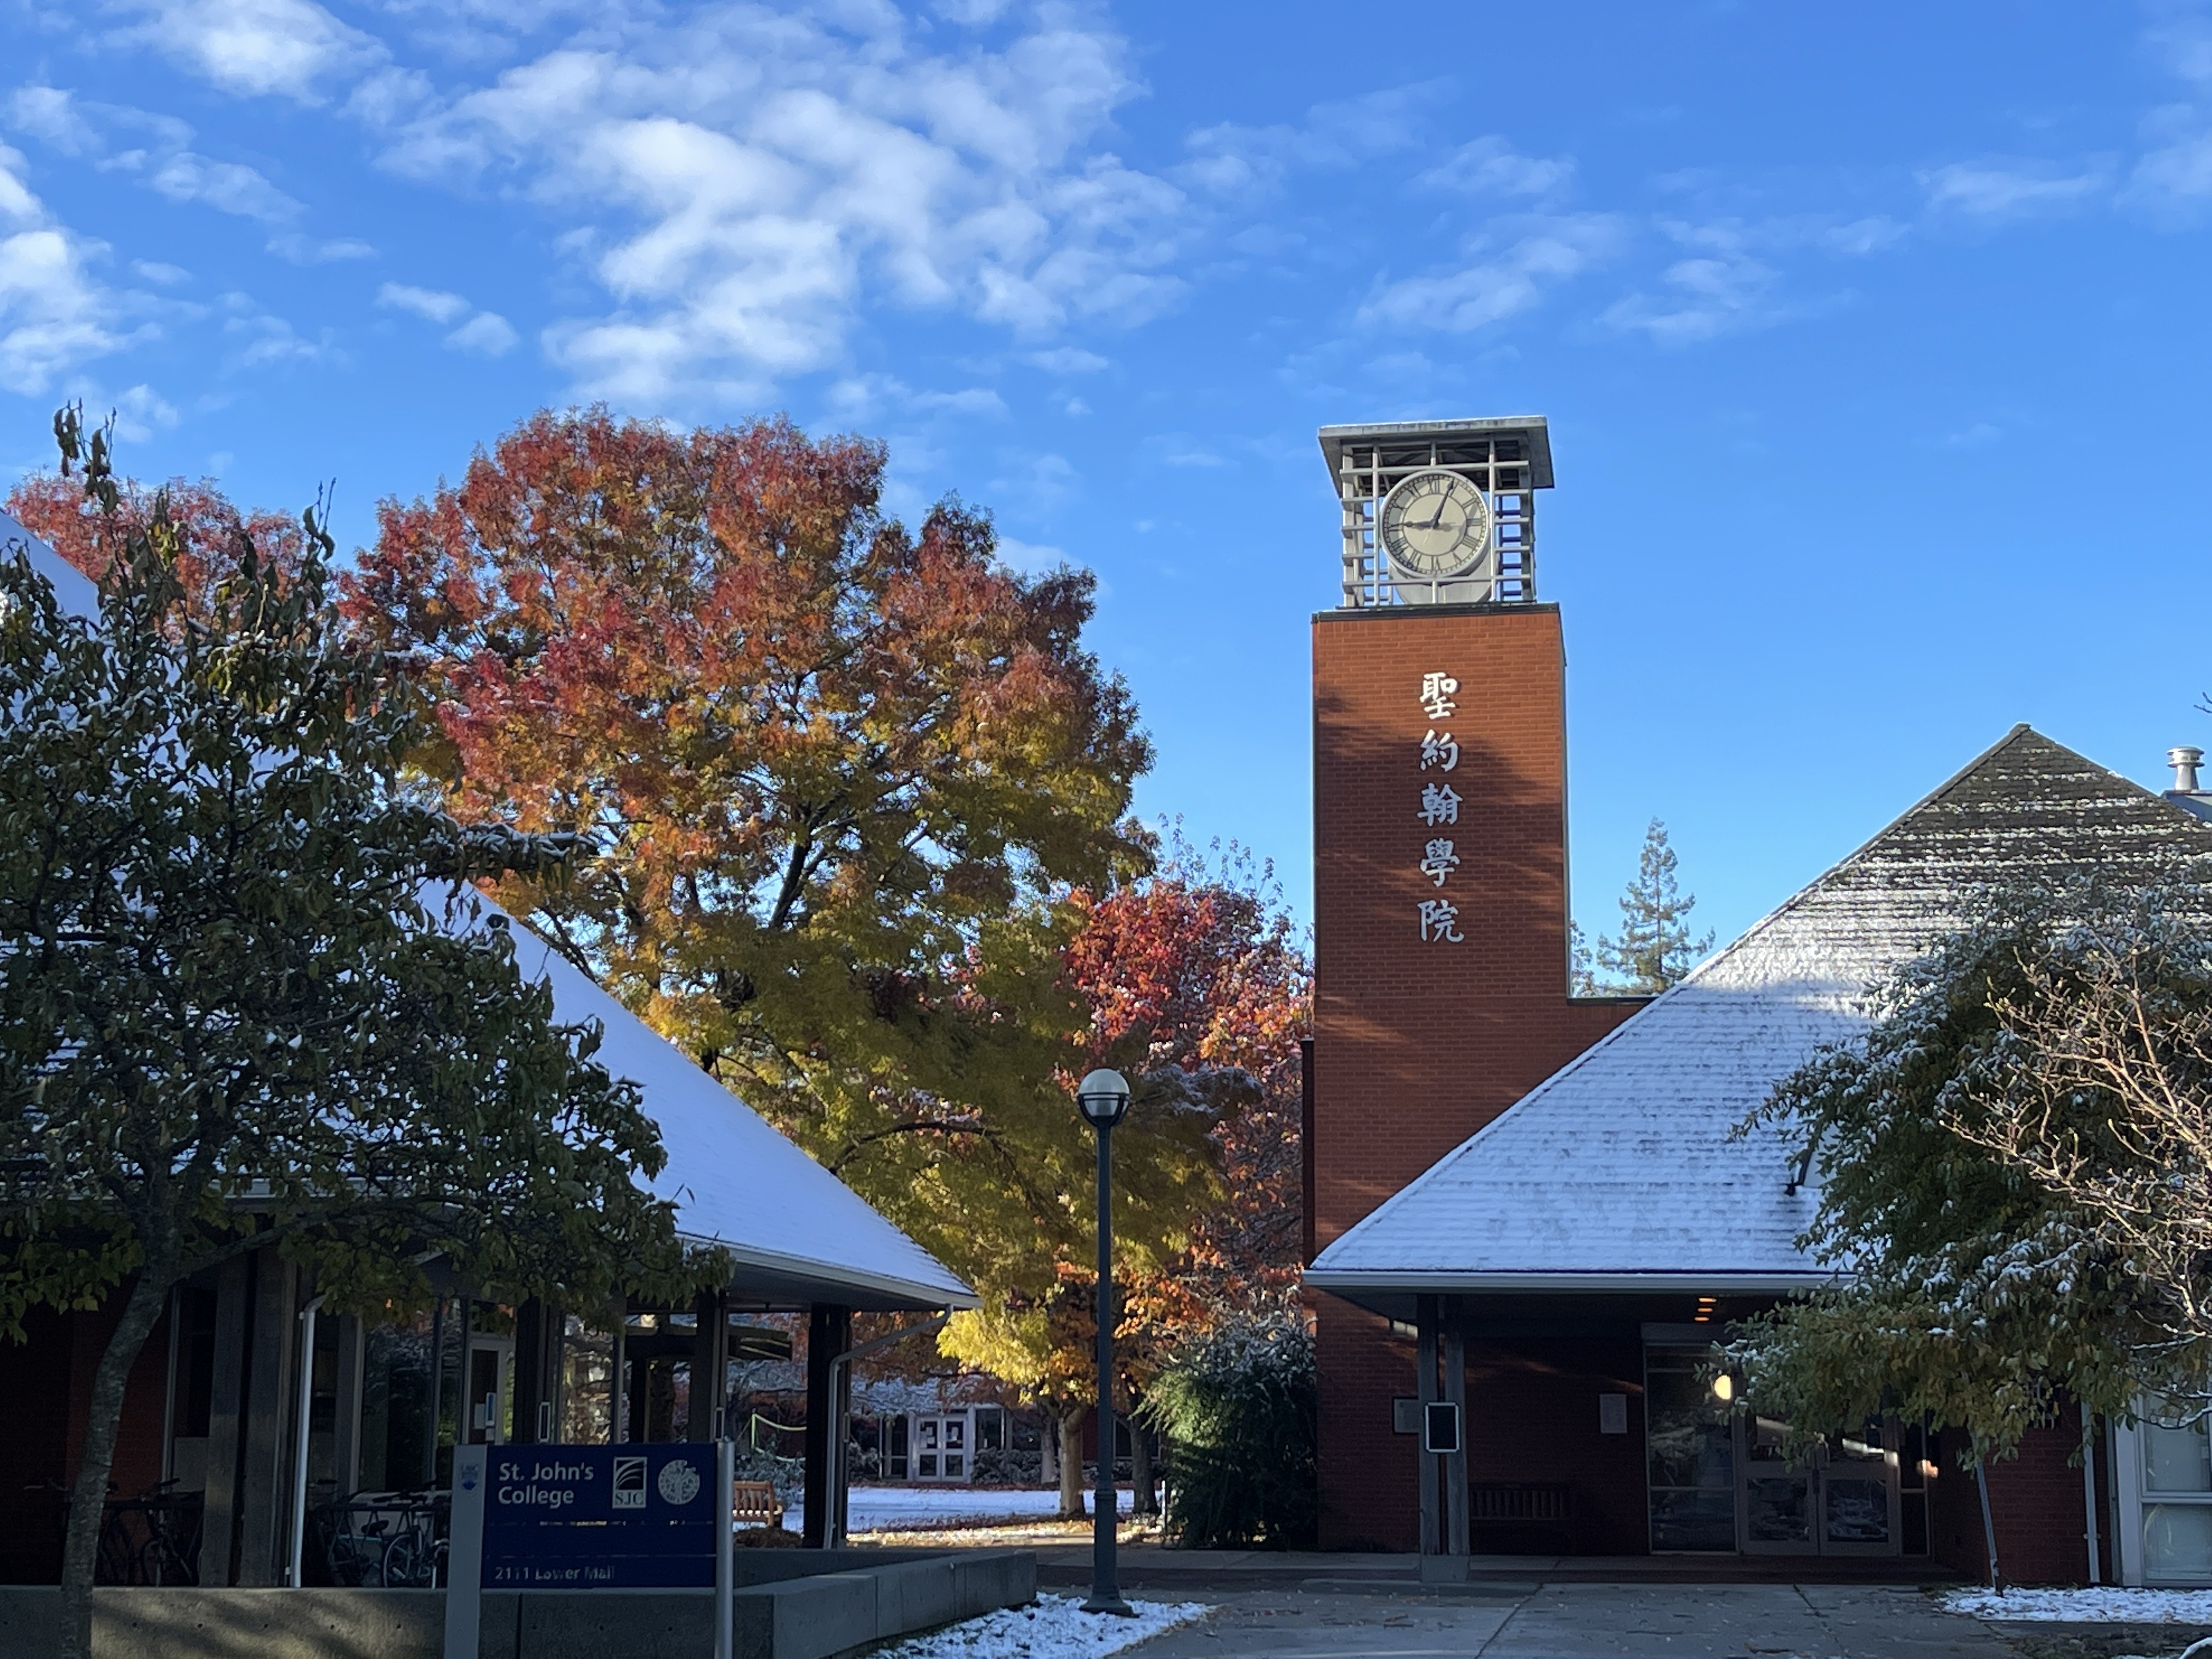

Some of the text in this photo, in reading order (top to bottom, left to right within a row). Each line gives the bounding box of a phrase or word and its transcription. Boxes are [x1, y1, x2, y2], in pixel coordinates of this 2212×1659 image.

[1417, 672, 1464, 942] 聖約翰學院
[499, 1462, 525, 1481] St.
[531, 1462, 594, 1481] John's
[498, 1485, 574, 1509] College
[615, 1492, 644, 1505] SJC
[495, 1565, 615, 1580] 2111 Lower Mall
